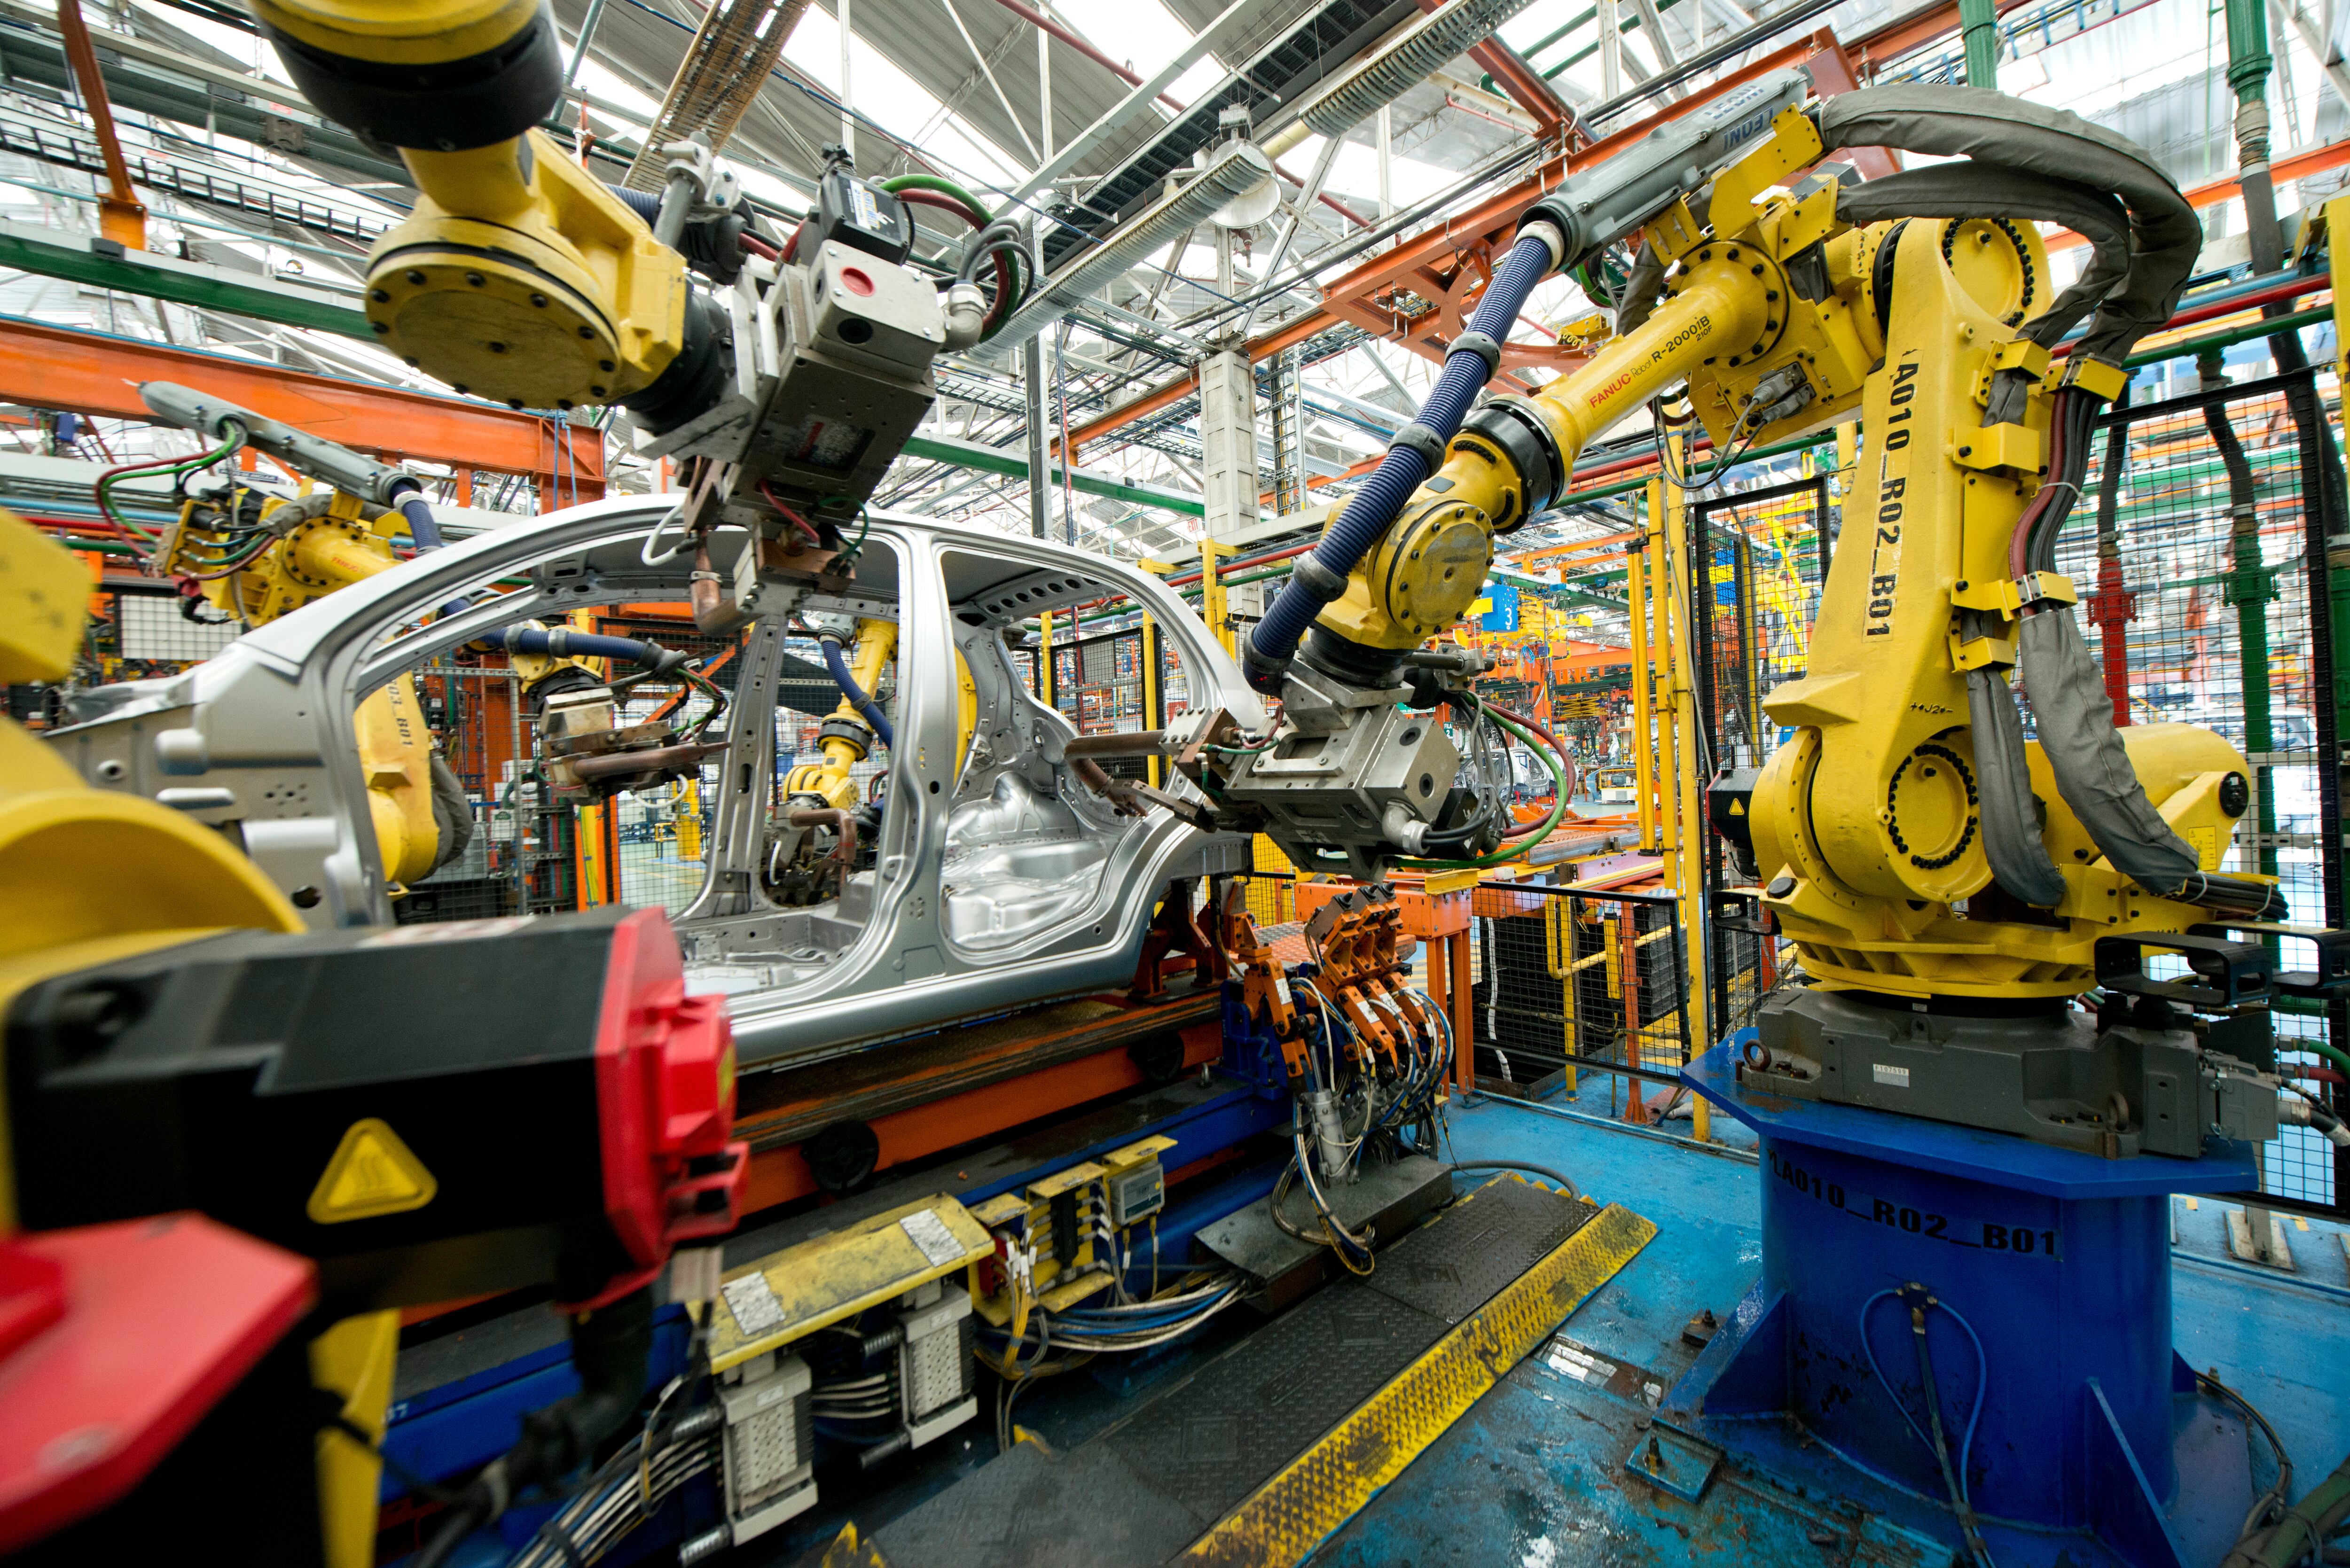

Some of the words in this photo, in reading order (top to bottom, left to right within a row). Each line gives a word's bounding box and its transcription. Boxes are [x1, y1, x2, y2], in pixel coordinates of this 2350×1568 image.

[1704, 86, 1764, 120] LEONI
[1723, 105, 1773, 151] LEONI
[1696, 325, 1712, 341] 210F
[1589, 373, 1631, 408] FANUC
[1630, 359, 1652, 378] Robot
[1651, 316, 1710, 363] R-2000iB
[1188, 519, 1198, 532] EXIT
[1505, 608, 1512, 626] 3
